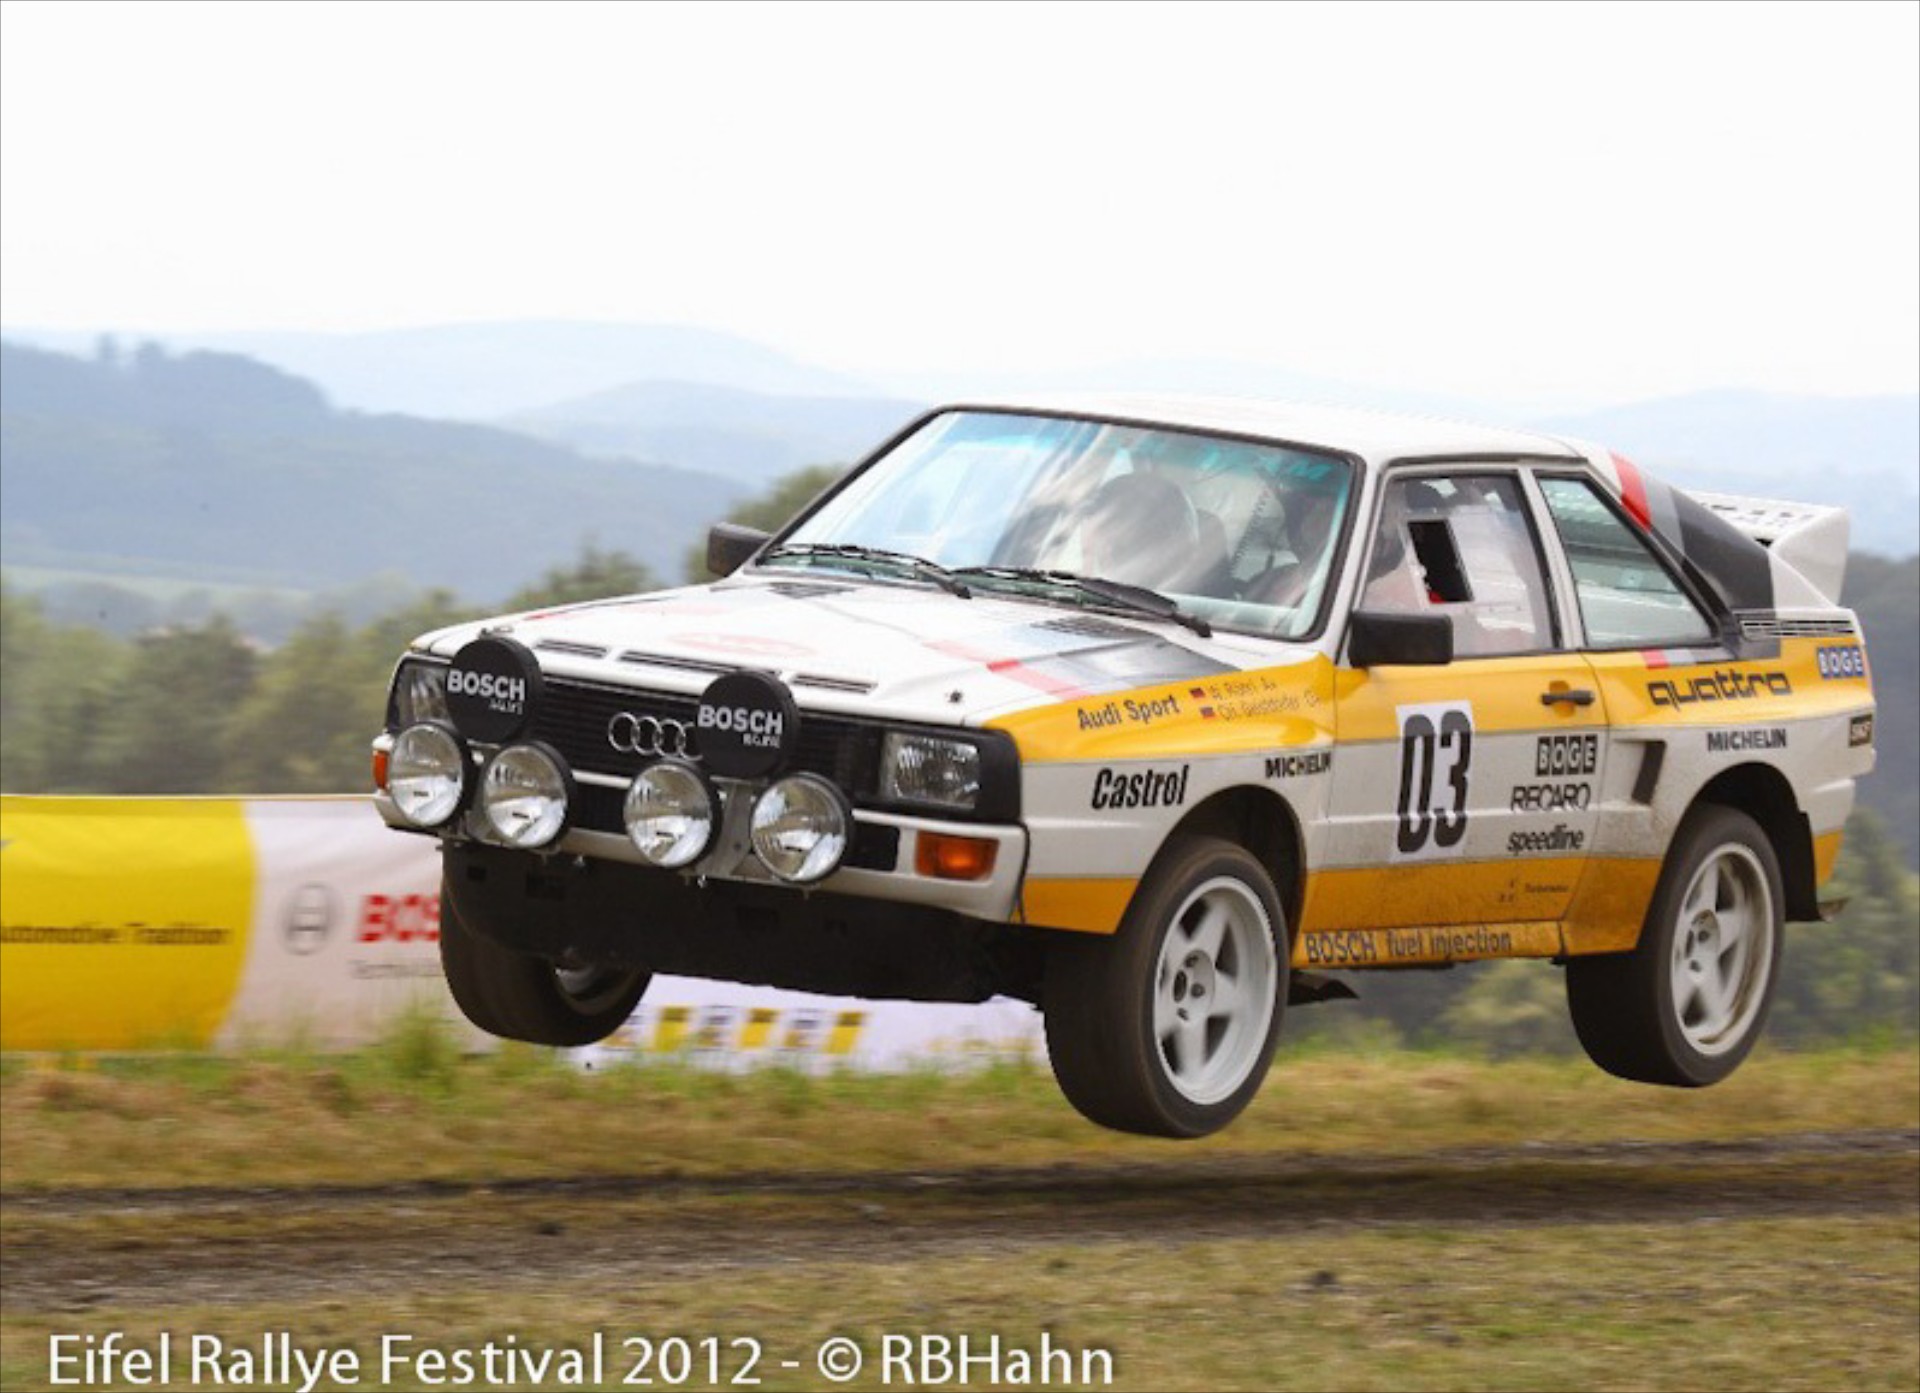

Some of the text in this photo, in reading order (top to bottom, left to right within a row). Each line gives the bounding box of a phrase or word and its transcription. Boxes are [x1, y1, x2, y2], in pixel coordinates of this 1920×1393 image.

[1817, 646, 1864, 678] BOGE
[448, 670, 525, 701] BOSCH
[1648, 669, 1791, 710] quattro
[698, 704, 782, 734] BOSCH
[1077, 695, 1179, 730] Audi Sport
[1536, 734, 1598, 776] BOGE
[1706, 728, 1787, 751] MICHELIN
[1091, 765, 1189, 809] Castrol
[1397, 710, 1471, 853] 03
[1510, 783, 1591, 811] RECARO
[1507, 823, 1584, 856] speedline
[1305, 924, 1513, 964] BOSCH fuel injection
